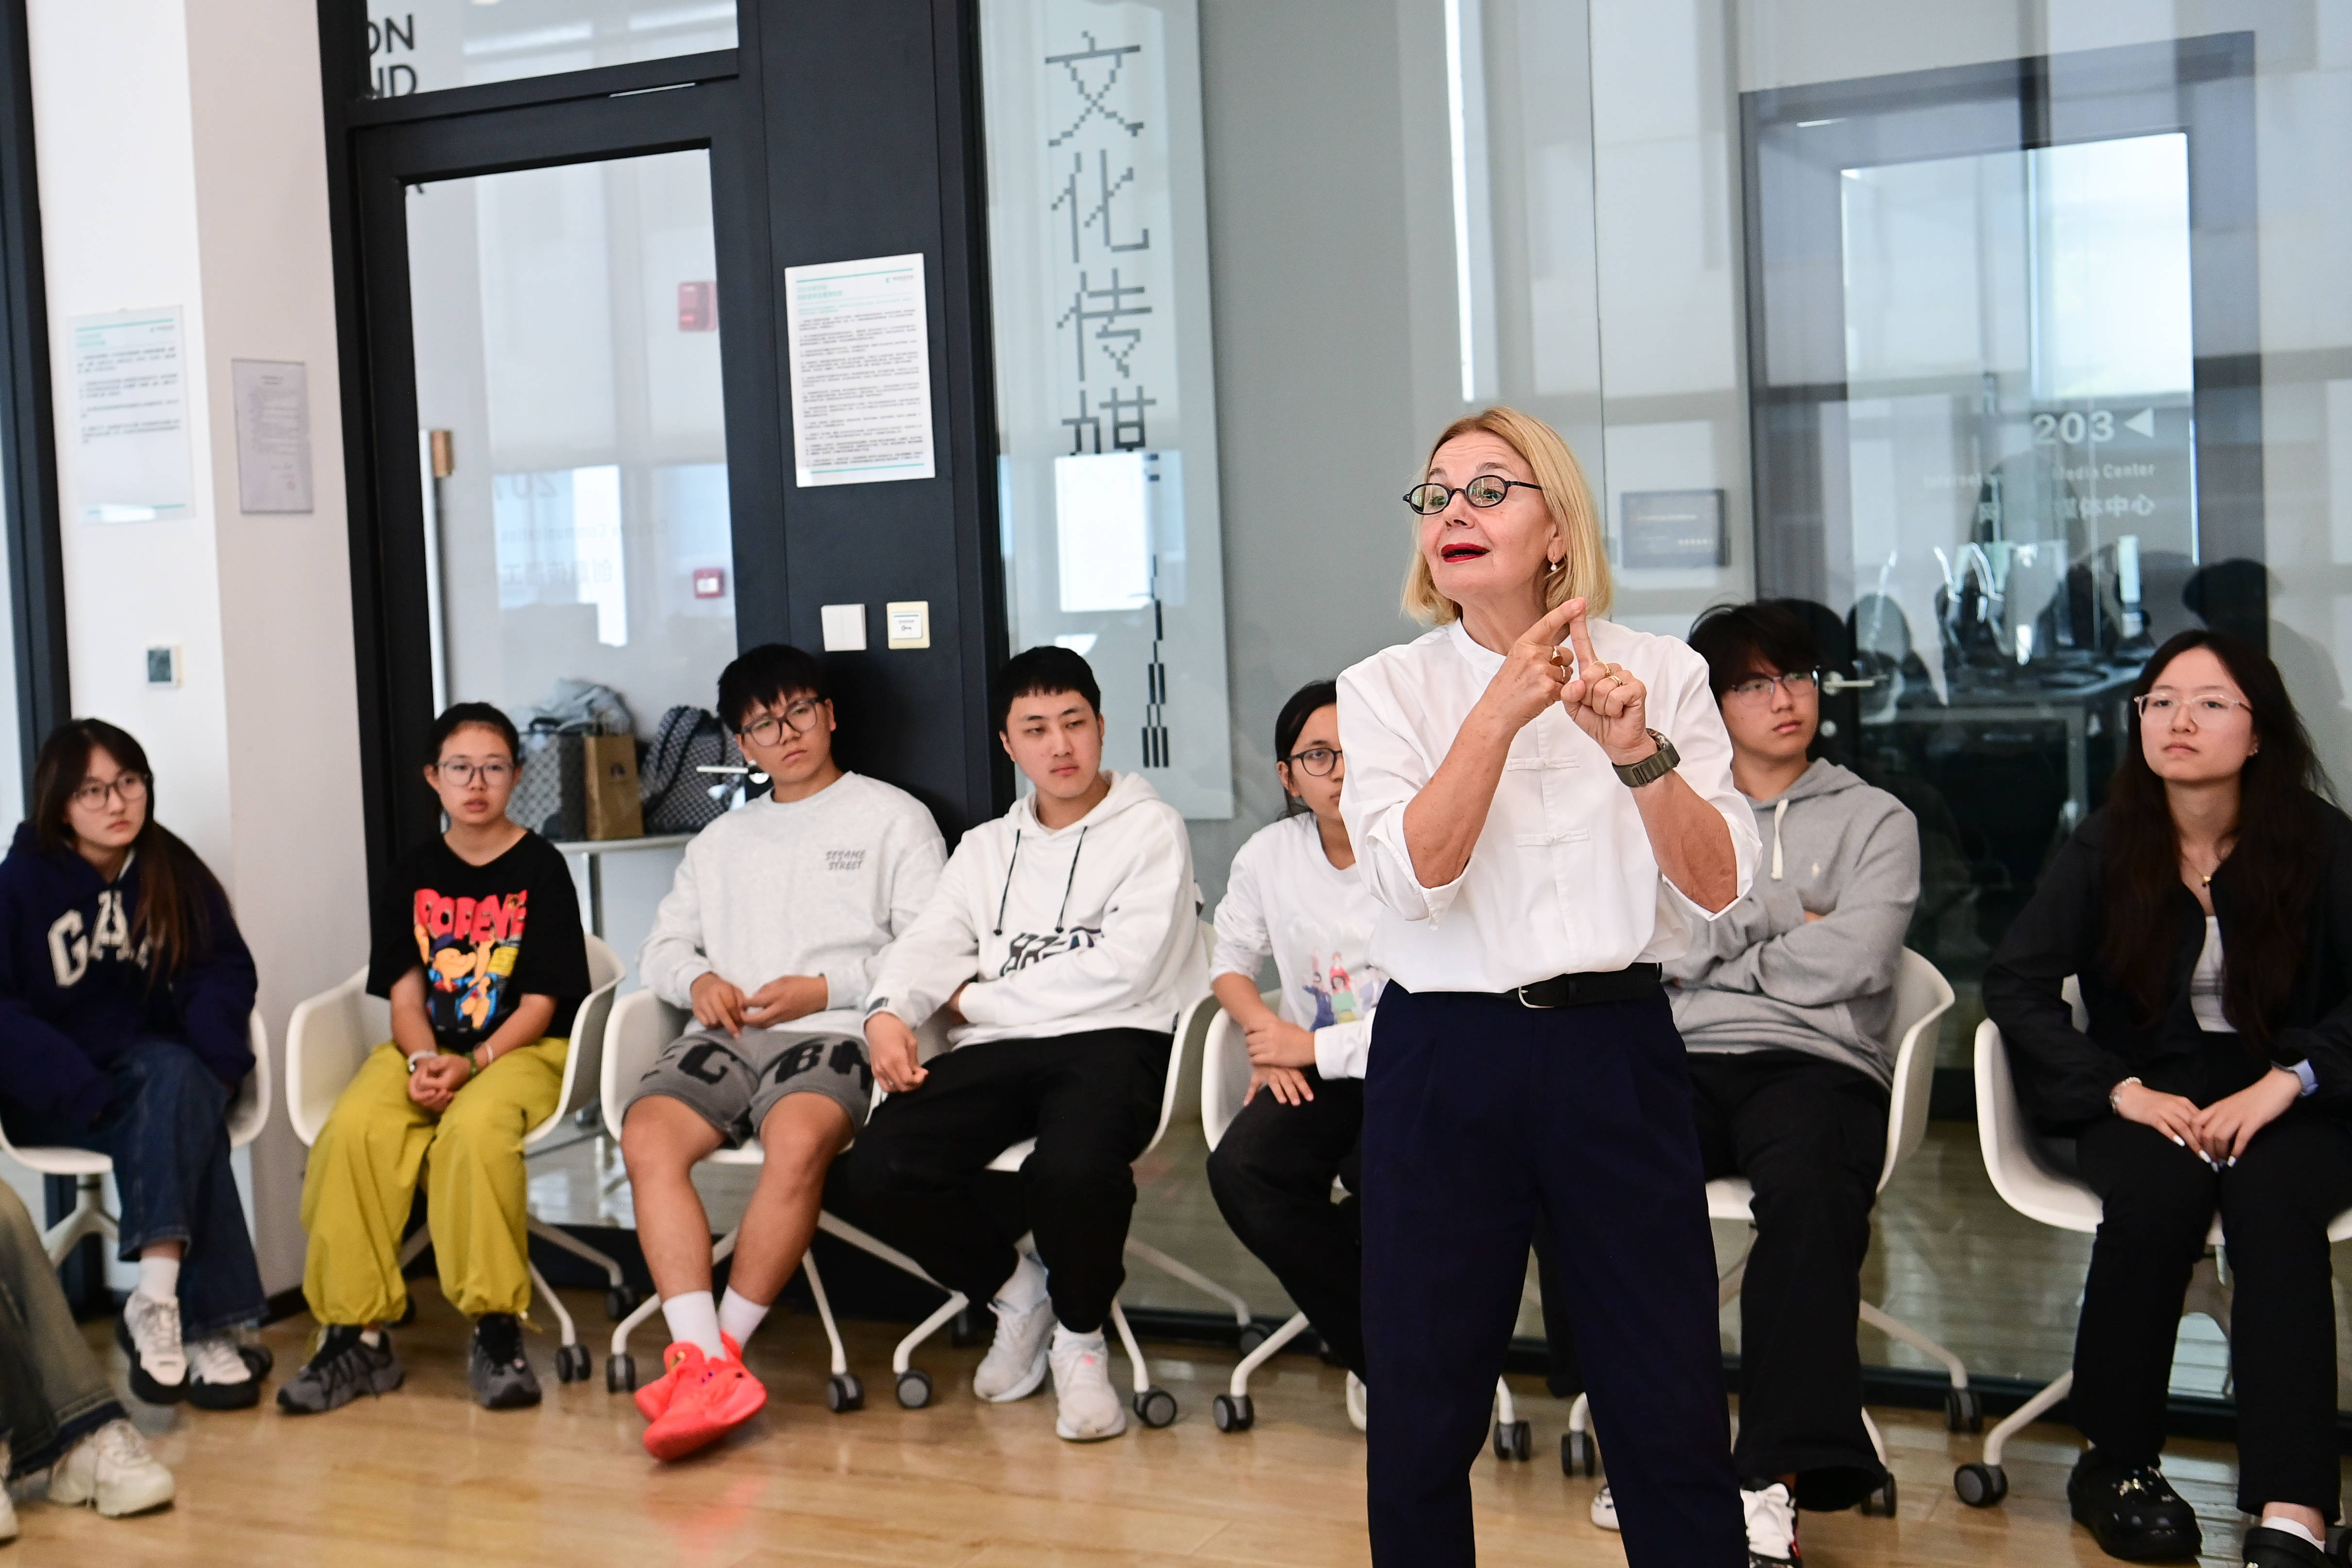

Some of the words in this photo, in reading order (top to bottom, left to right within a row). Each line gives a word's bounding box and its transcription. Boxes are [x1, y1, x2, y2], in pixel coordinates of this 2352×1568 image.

[2033, 409, 2114, 444] 203
[2103, 462, 2155, 479] Center
[825, 850, 866, 860] SESAME
[828, 860, 863, 870] STREET
[414, 888, 528, 942] POPEYE
[48, 890, 165, 988] GA
